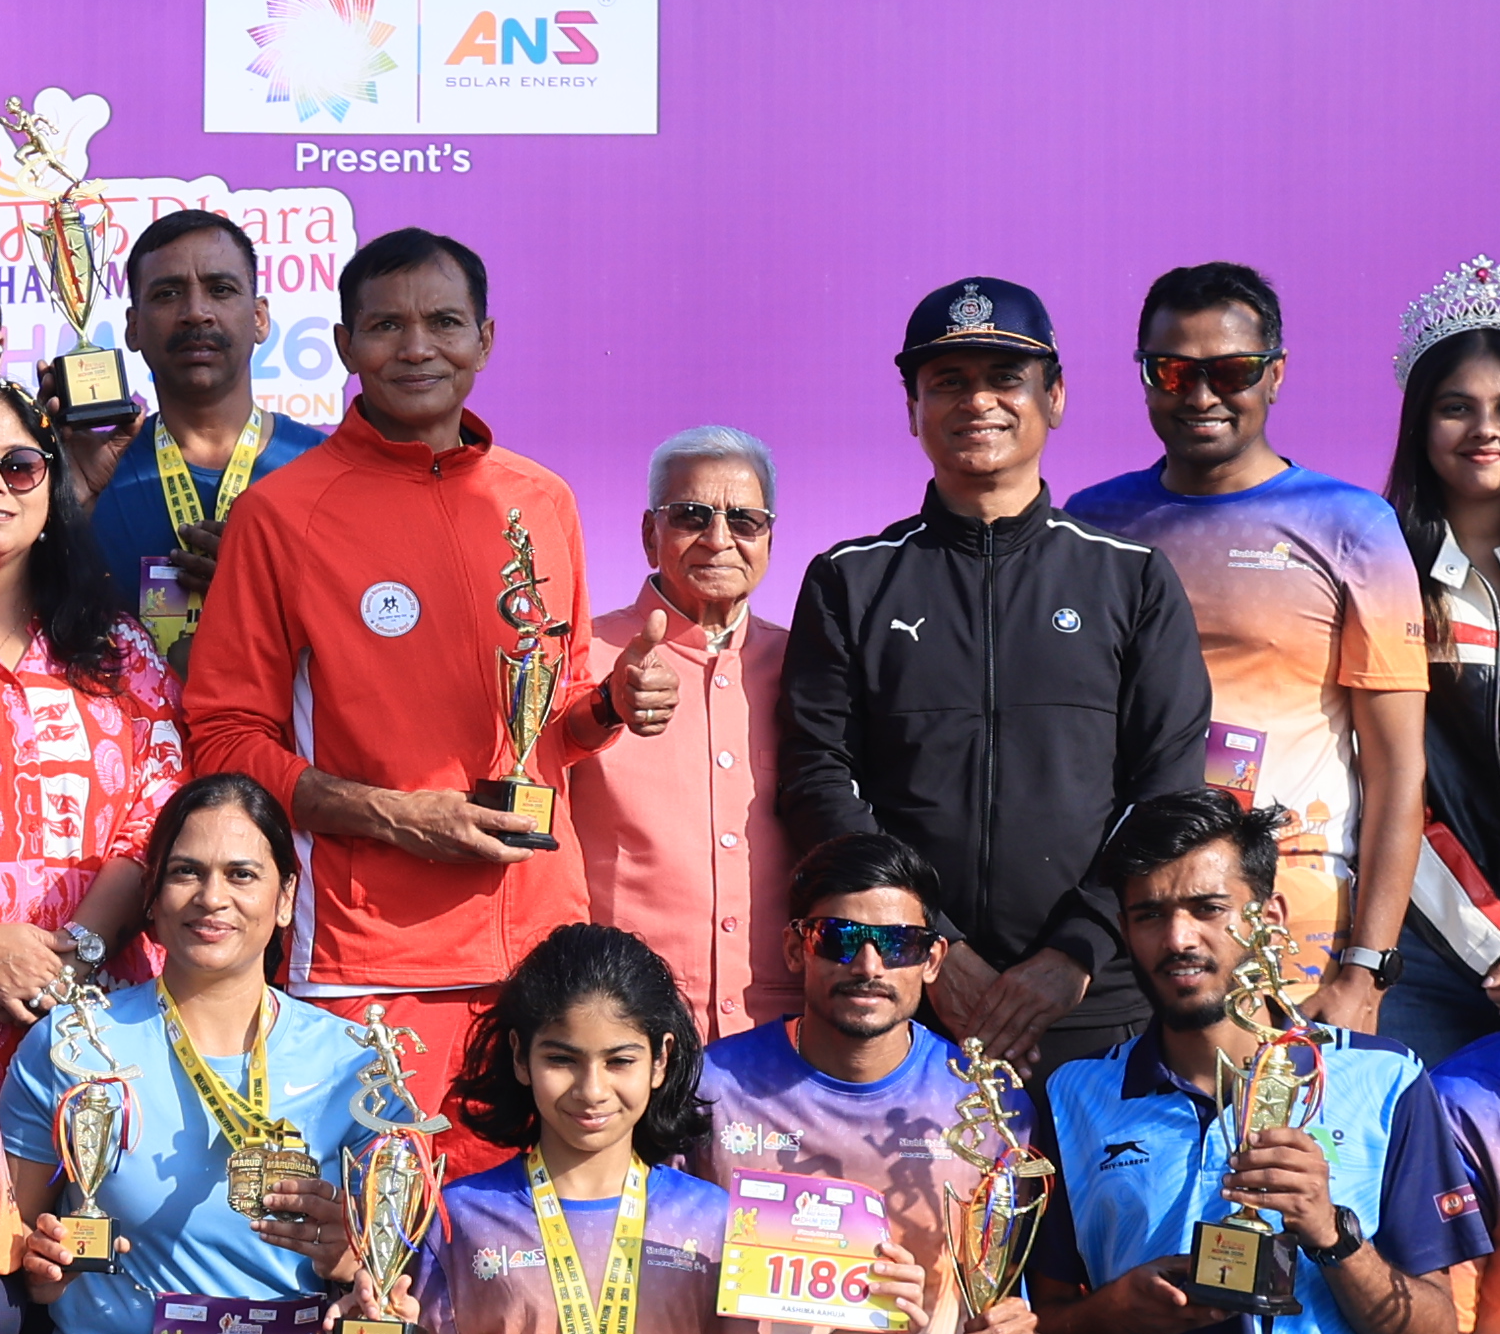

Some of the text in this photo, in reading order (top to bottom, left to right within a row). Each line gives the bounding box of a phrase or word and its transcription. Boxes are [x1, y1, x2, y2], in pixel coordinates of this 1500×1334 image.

[444, 10, 600, 65] ANS
[445, 76, 599, 88] SOLAR ENERGY
[294, 142, 472, 173] Present's
[768, 1254, 870, 1304] 1186
